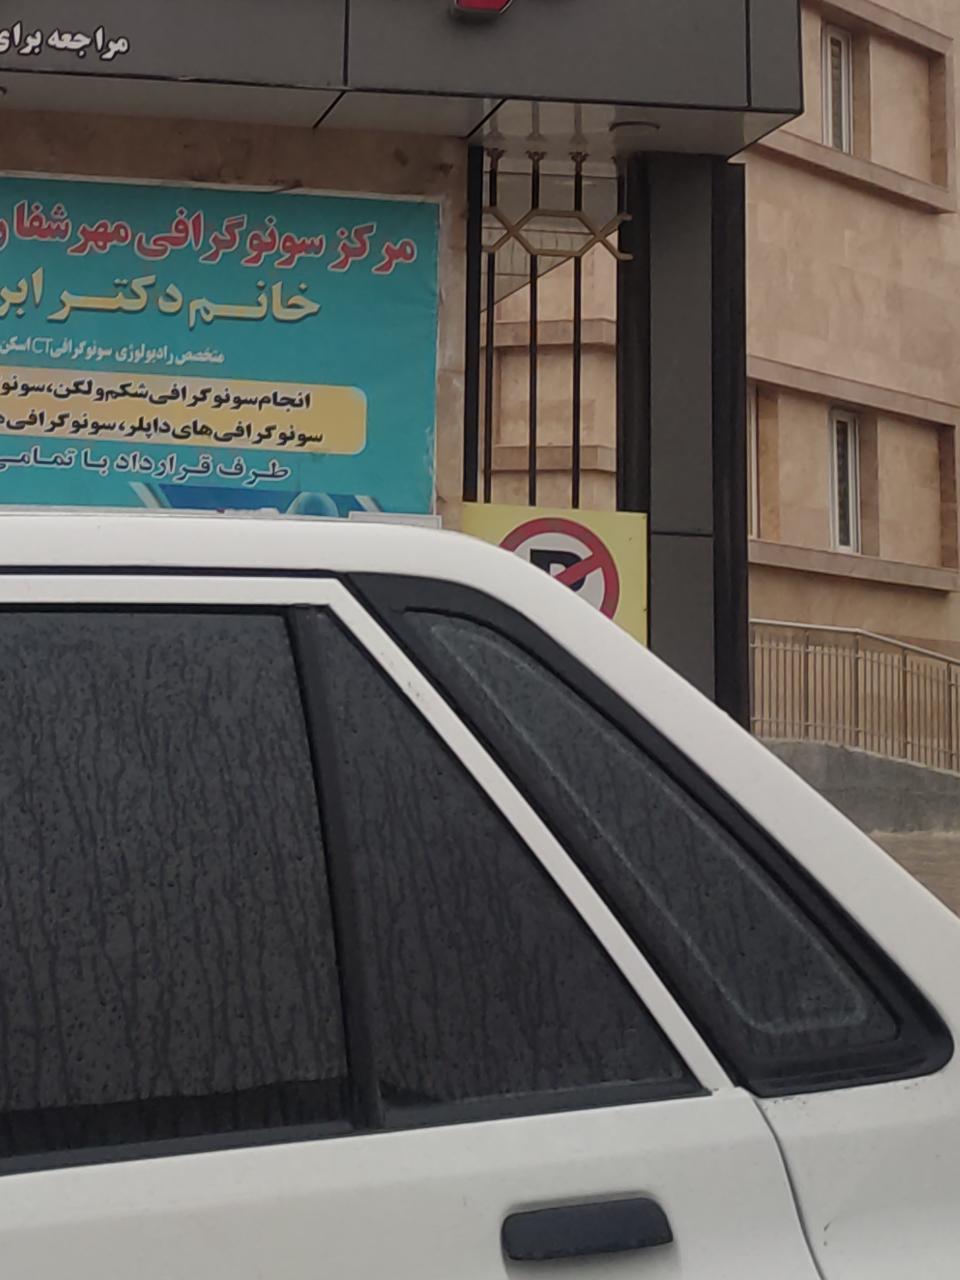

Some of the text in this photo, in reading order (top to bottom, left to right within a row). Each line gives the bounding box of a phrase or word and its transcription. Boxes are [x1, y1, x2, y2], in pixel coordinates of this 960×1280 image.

[47, 27, 130, 59] مراجعه
[13, 200, 72, 241] شفا
[67, 219, 132, 255] مهر
[135, 207, 327, 268] سونوگرافی
[327, 222, 417, 274] مرکز
[47, 275, 184, 321] دکتر
[189, 279, 321, 331] خانم
[50, 338, 113, 360] سونوگرافی
[115, 343, 175, 366] رادیولوژی
[175, 347, 225, 365] متخصص
[95, 388, 105, 402] و
[105, 381, 149, 402] شکم
[149, 383, 258, 410] سونوگرافی
[258, 391, 311, 412] انجام
[83, 449, 110, 476] با
[115, 451, 212, 482] قرارداد
[217, 454, 290, 485] طرف
